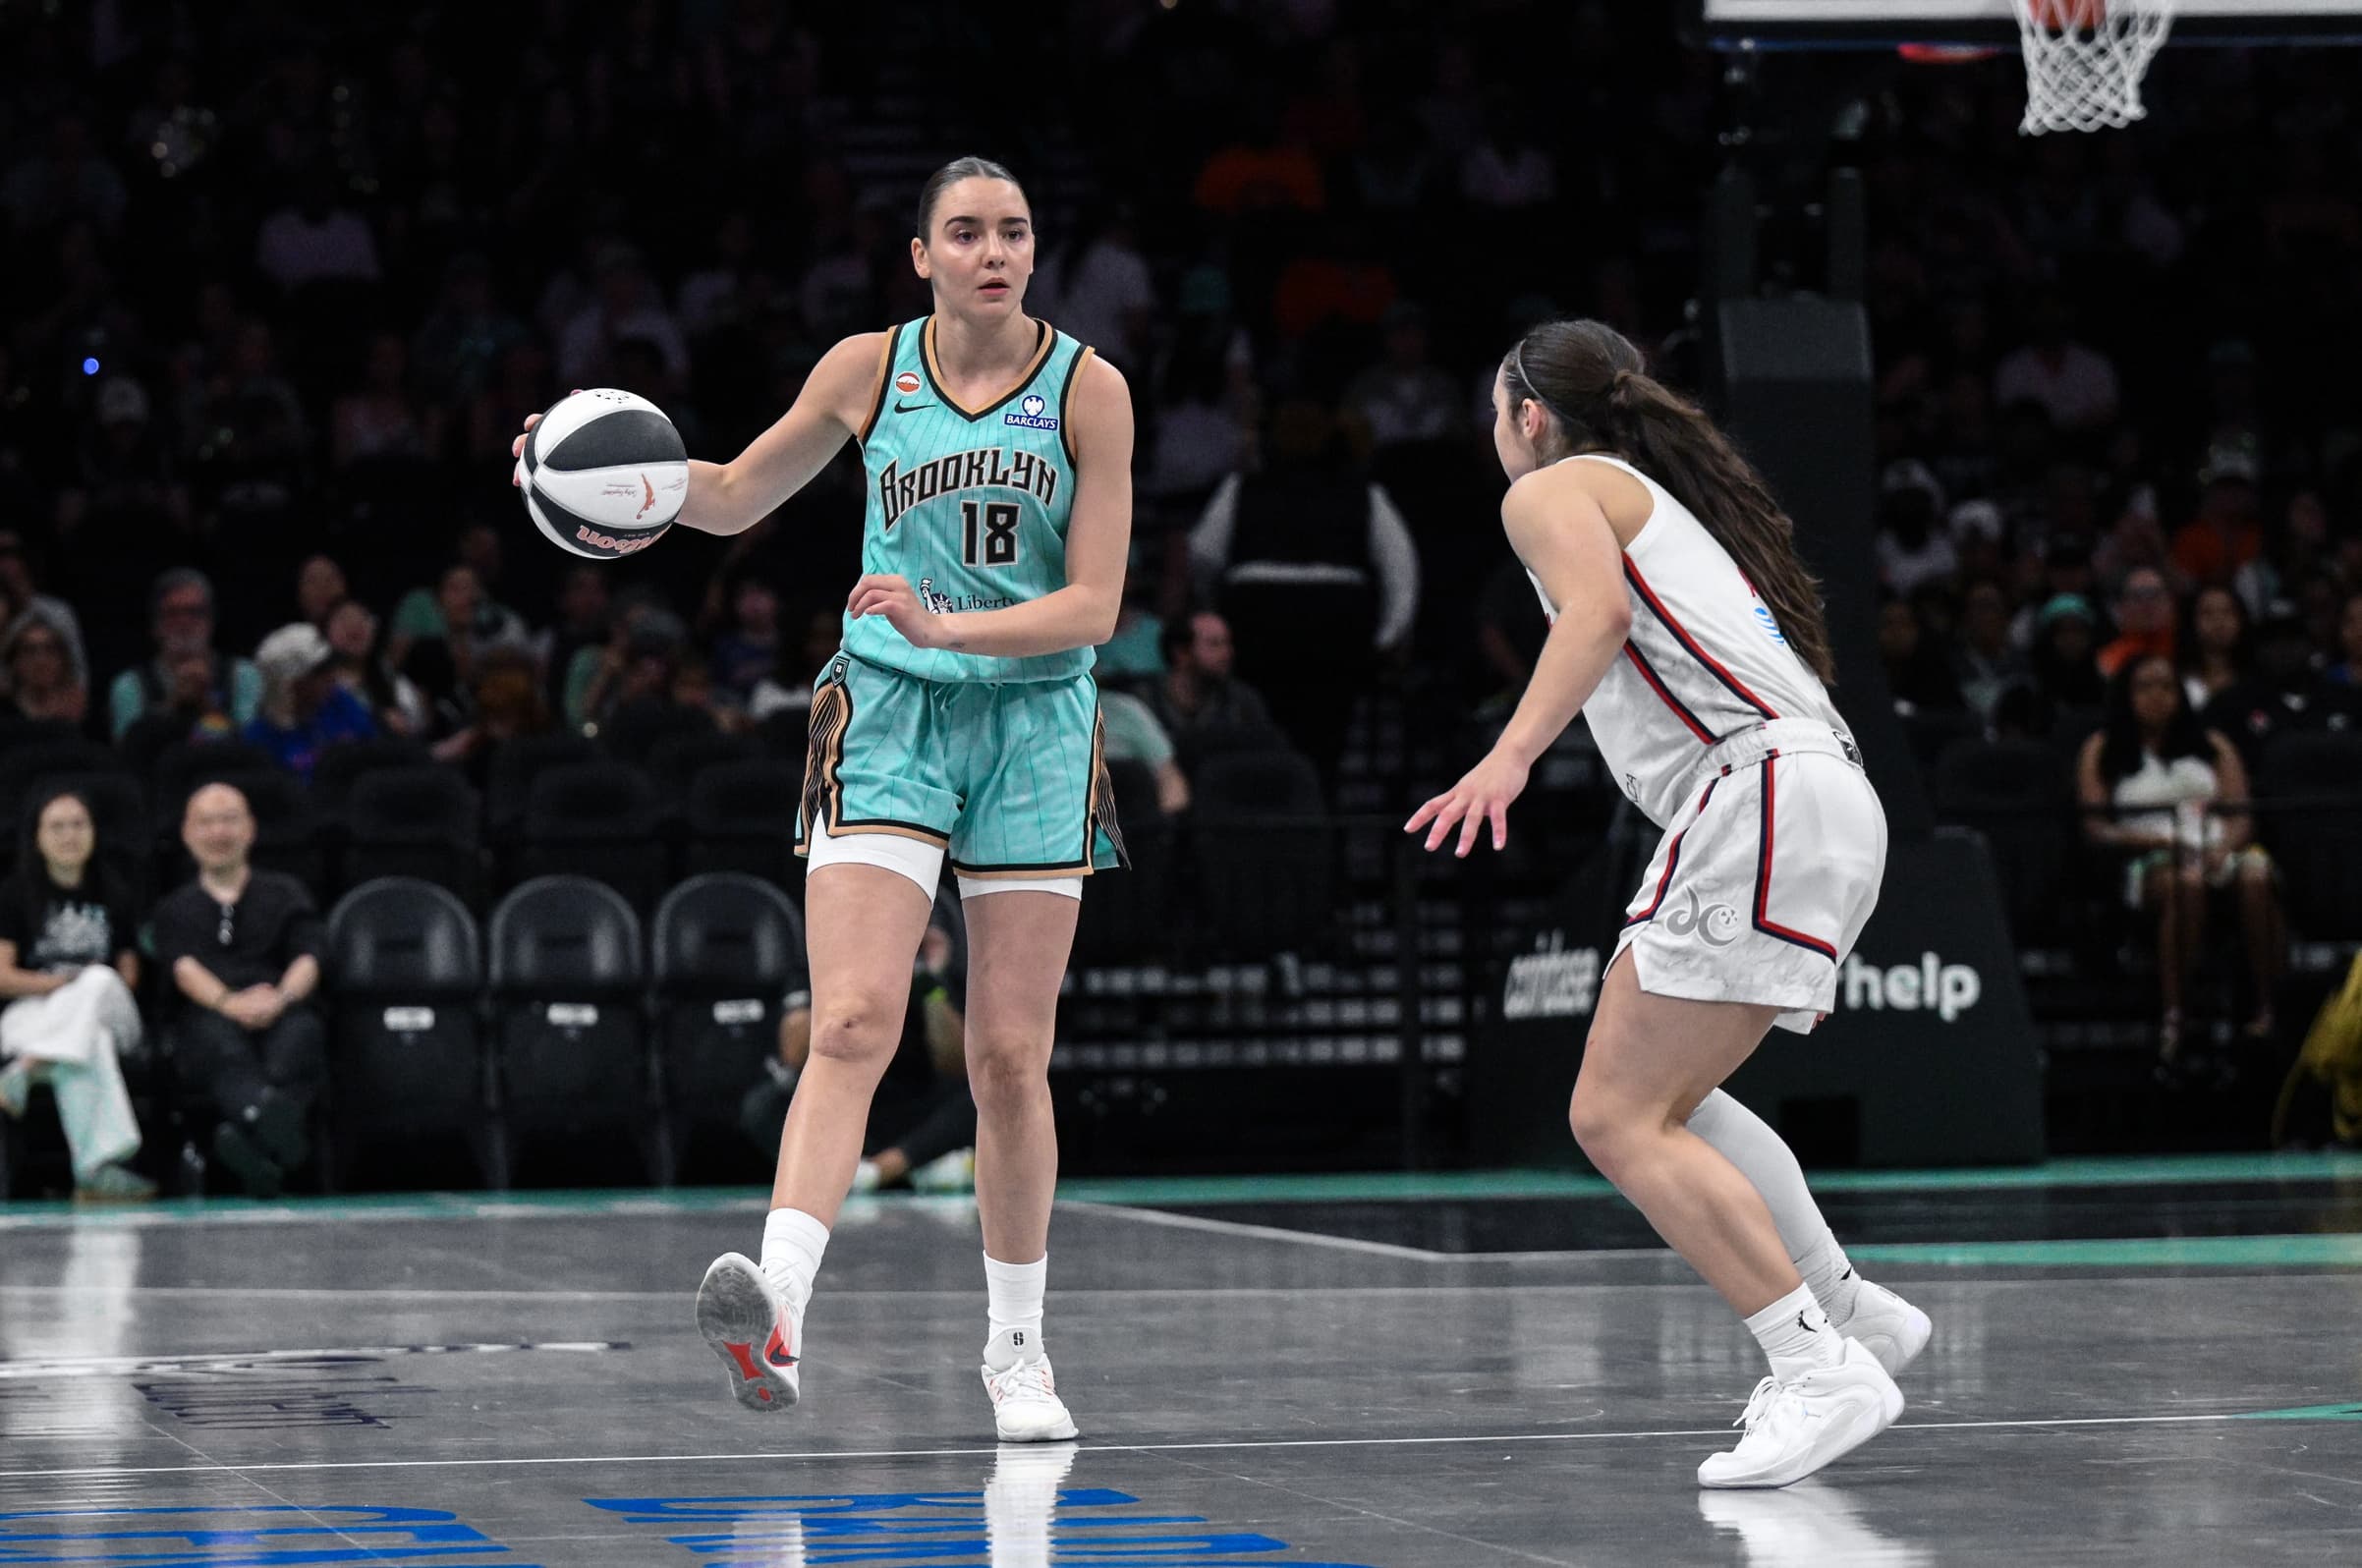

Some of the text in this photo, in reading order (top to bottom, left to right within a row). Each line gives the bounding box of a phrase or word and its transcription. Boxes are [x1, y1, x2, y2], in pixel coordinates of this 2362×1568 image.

[1006, 415, 1056, 429] BARCLAYS
[960, 499, 1022, 567] 18
[1836, 950, 1981, 1023] help
